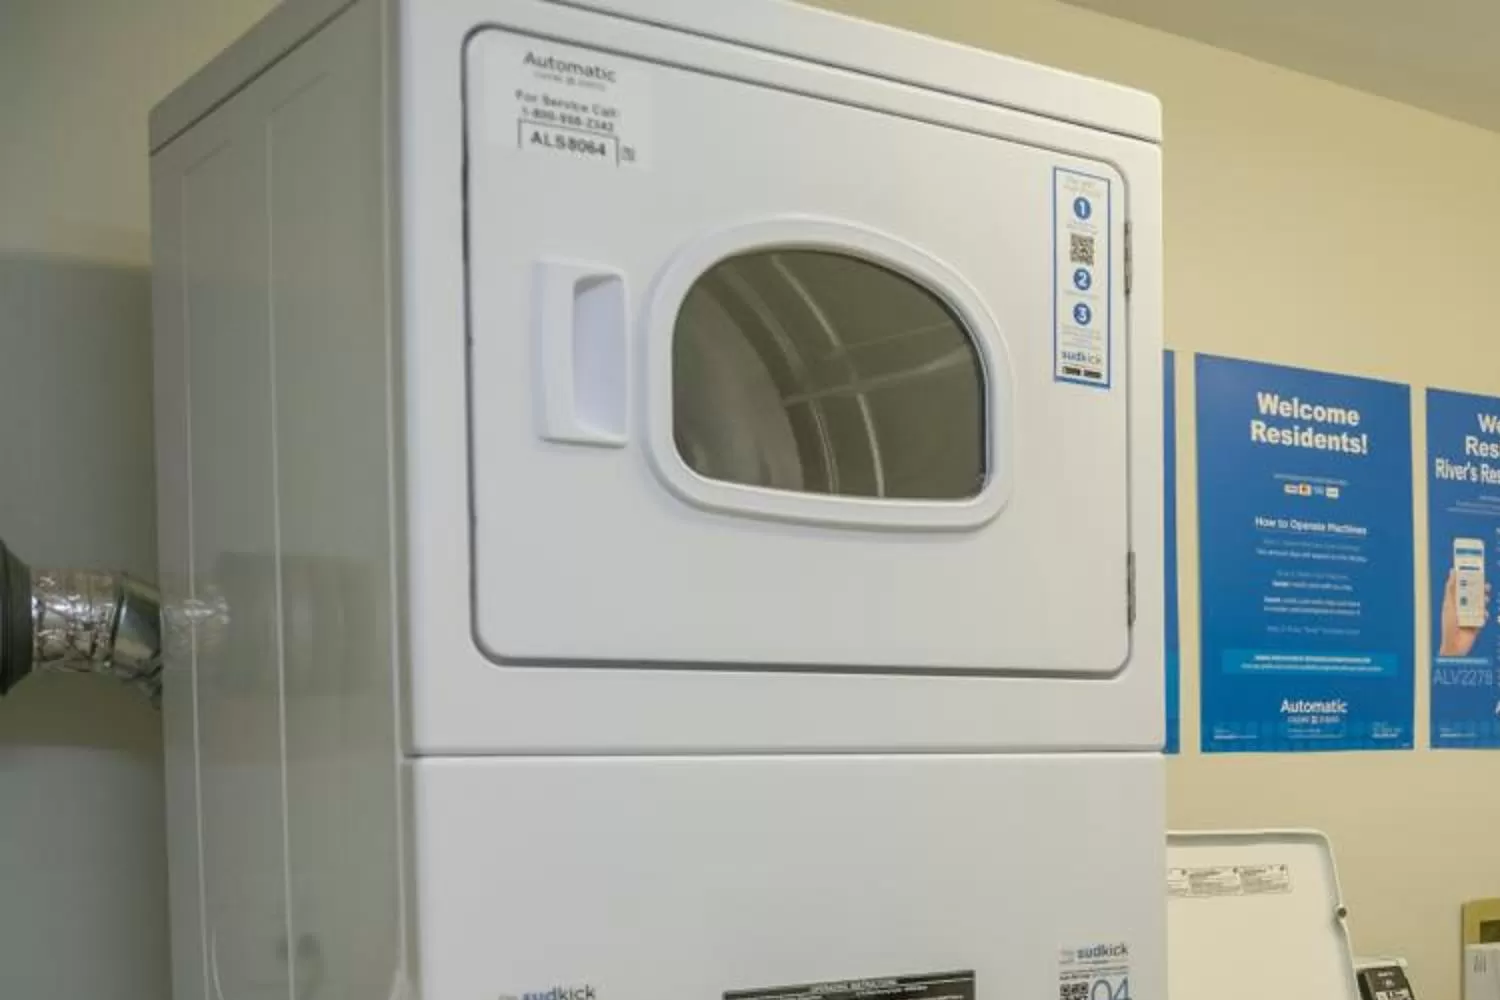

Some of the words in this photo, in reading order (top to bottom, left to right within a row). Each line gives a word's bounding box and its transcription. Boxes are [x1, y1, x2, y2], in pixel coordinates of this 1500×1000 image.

[523, 51, 616, 83] Automatic
[1256, 391, 1360, 427] Welcome
[1250, 419, 1369, 455] Residents!
[1435, 458, 1478, 482] River's
[1255, 516, 1276, 529] How
[1278, 518, 1288, 529] to
[1290, 519, 1325, 533] Operate
[1280, 698, 1348, 714] Automatic
[1077, 942, 1128, 959] sudkick
